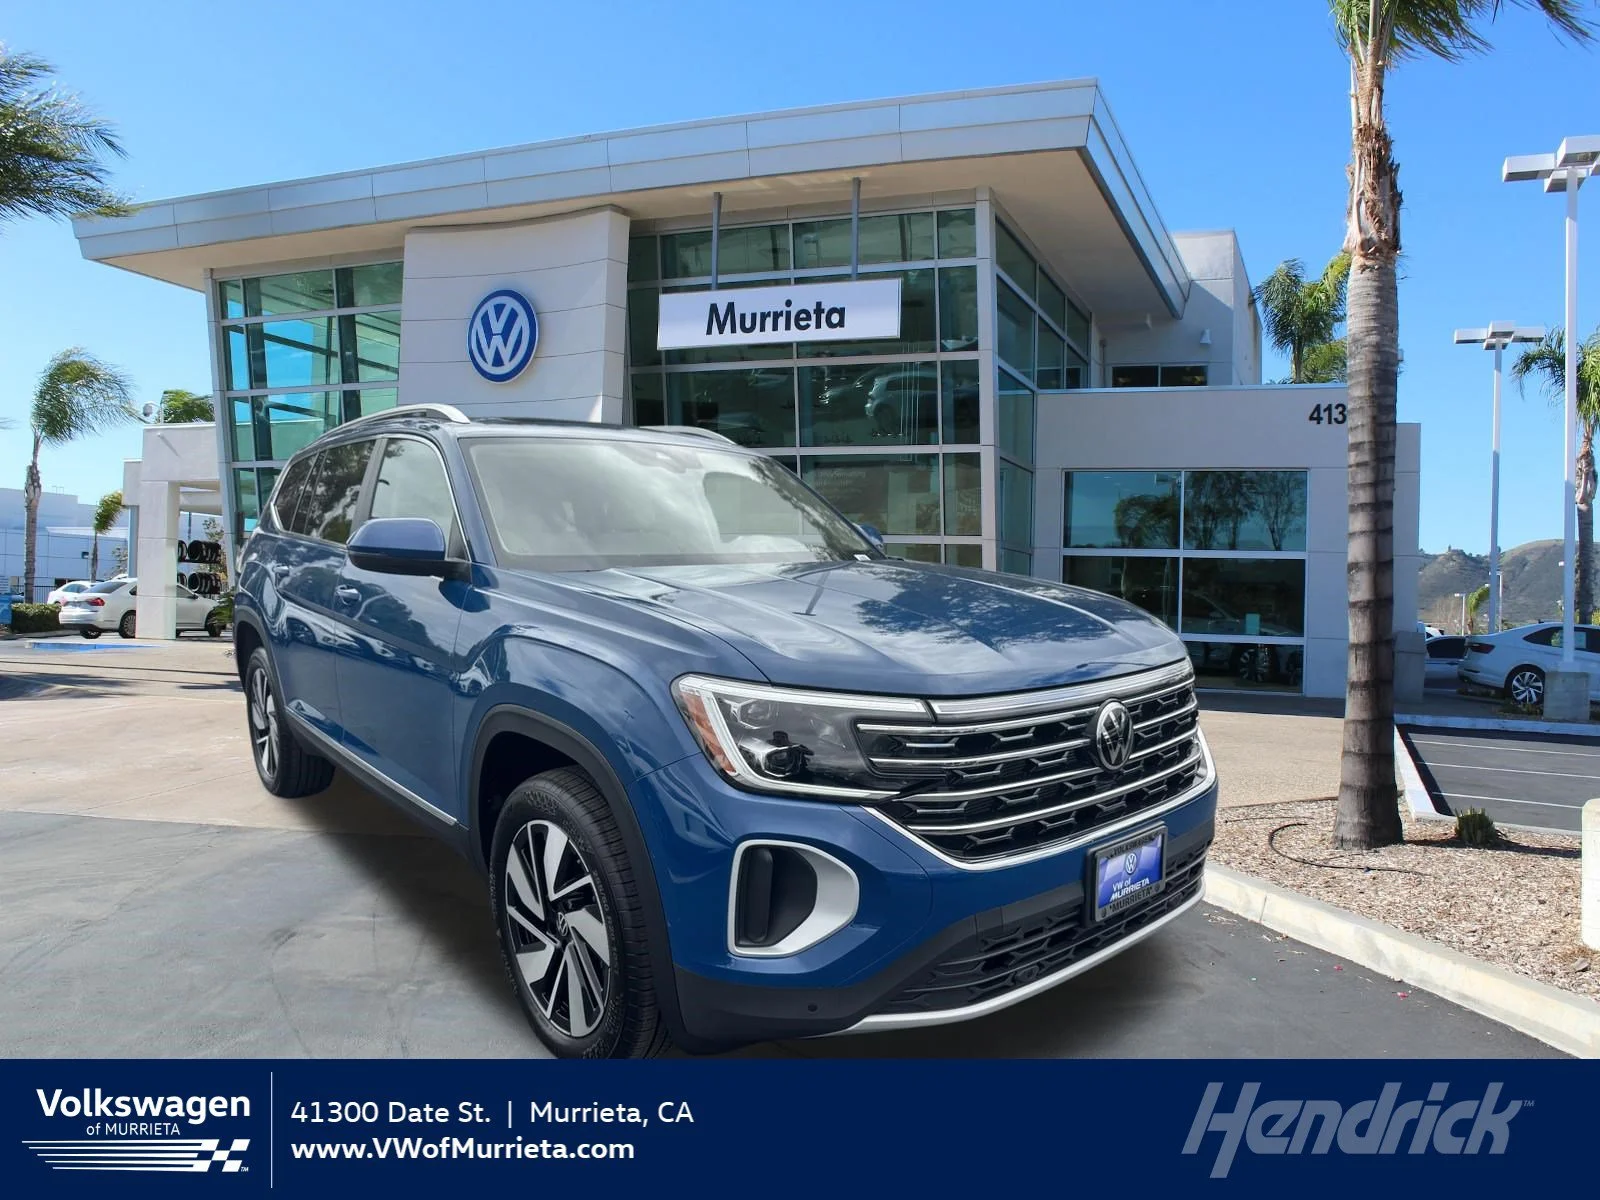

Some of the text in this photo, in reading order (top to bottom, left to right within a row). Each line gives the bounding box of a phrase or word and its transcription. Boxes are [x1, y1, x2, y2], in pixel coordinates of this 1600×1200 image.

[706, 299, 846, 335] Murrieta
[470, 295, 532, 376] VW
[1109, 877, 1150, 902] MURRIETA
[1113, 877, 1132, 892] VW of
